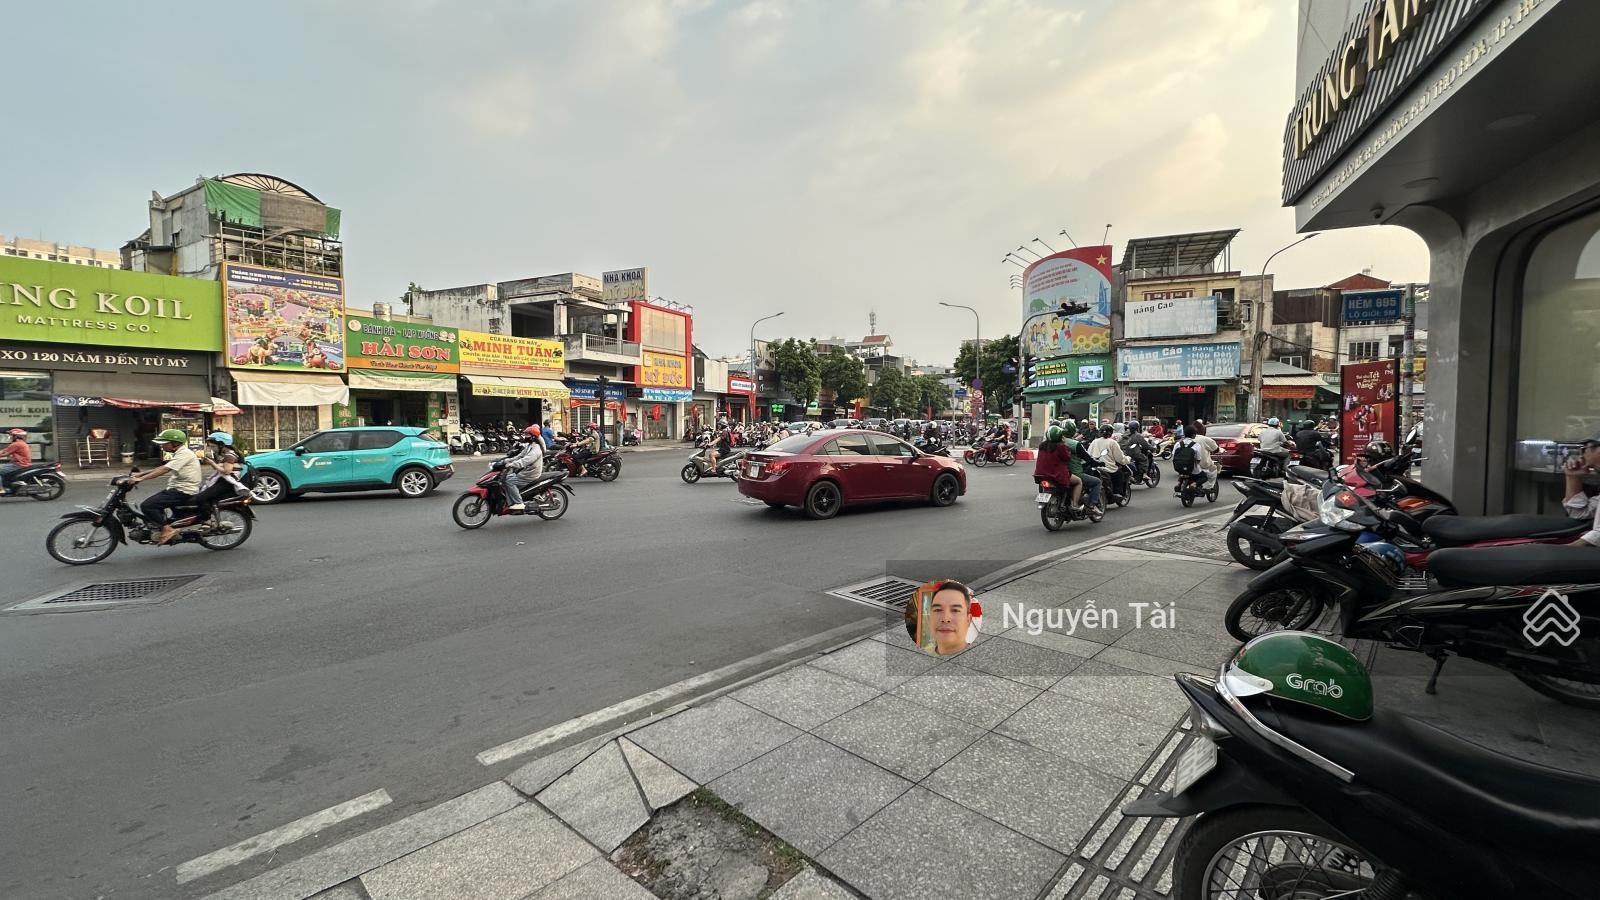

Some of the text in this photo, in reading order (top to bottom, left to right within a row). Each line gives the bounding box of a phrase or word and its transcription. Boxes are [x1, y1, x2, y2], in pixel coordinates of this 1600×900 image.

[1493, 16, 1515, 44] TP.
[1292, 38, 1358, 161] TRUNG
[604, 271, 641, 283] NHA KHOA
[95, 291, 193, 321] KOIL
[1348, 296, 1373, 309] HẺM
[18, 314, 159, 334] MATTRESS CO.
[363, 323, 382, 334] BÁNH
[361, 336, 451, 361] HẢI SƠN
[473, 340, 553, 358] MINH TUẤN
[1162, 346, 1183, 357] Cáo
[1, 350, 190, 369] XO 120 NĂM ĐẾN TỪ MỸ
[1286, 673, 1343, 699] Grab
